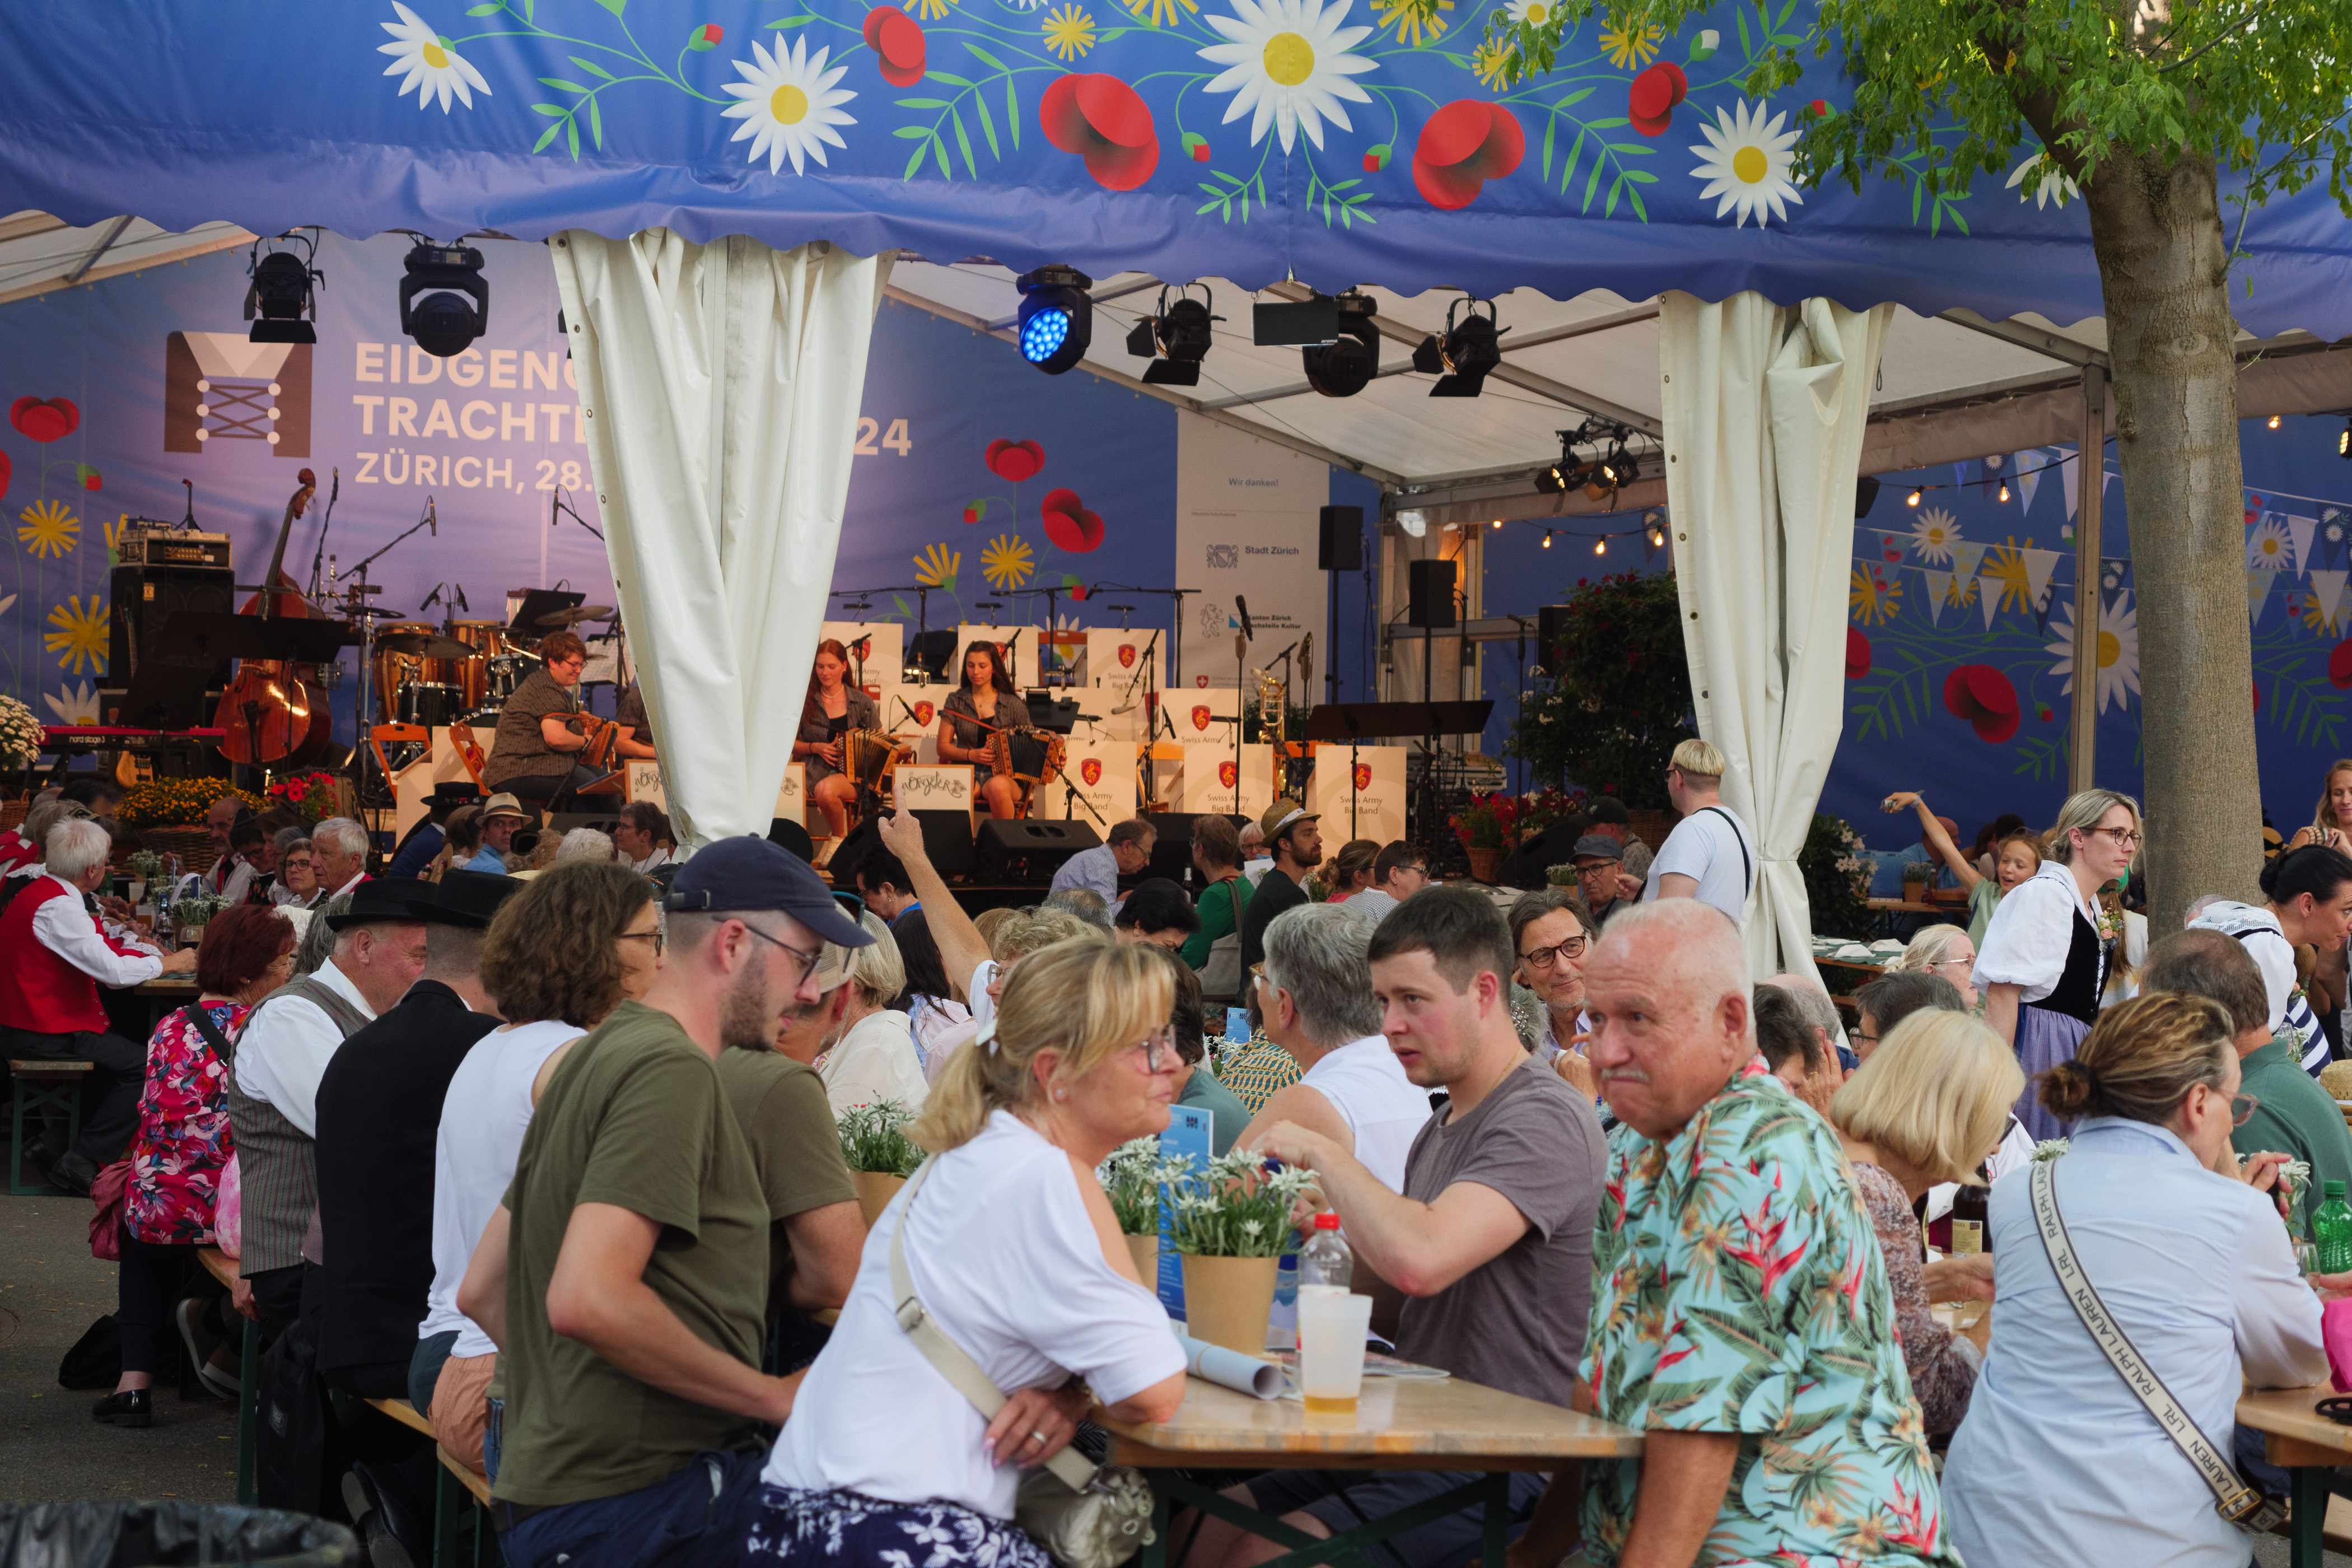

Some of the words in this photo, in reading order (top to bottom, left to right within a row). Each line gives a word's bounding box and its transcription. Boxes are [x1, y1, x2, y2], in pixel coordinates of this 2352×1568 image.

[355, 448, 525, 494] ZÜRICH,
[535, 459, 592, 492] 28.
[1229, 478, 1243, 486] Wir
[1245, 478, 1279, 487] danken!
[1245, 545, 1269, 554] Stadt
[1271, 546, 1299, 555] Zürich
[862, 668, 881, 677] Army
[1112, 682, 1123, 690] Big
[85, 735, 101, 744] stage
[1092, 792, 1113, 802] Army
[1230, 795, 1250, 805] Amy
[1362, 796, 1383, 806] Army
[1074, 802, 1086, 812] Big
[2039, 1193, 2059, 1239] RALPH
[2057, 1248, 2076, 1279] LRL
[2074, 1287, 2118, 1347] LAUREN
[2114, 1347, 2156, 1396] RALPH
[2162, 1403, 2186, 1434] LRL
[2189, 1439, 2234, 1493] LAUREN
